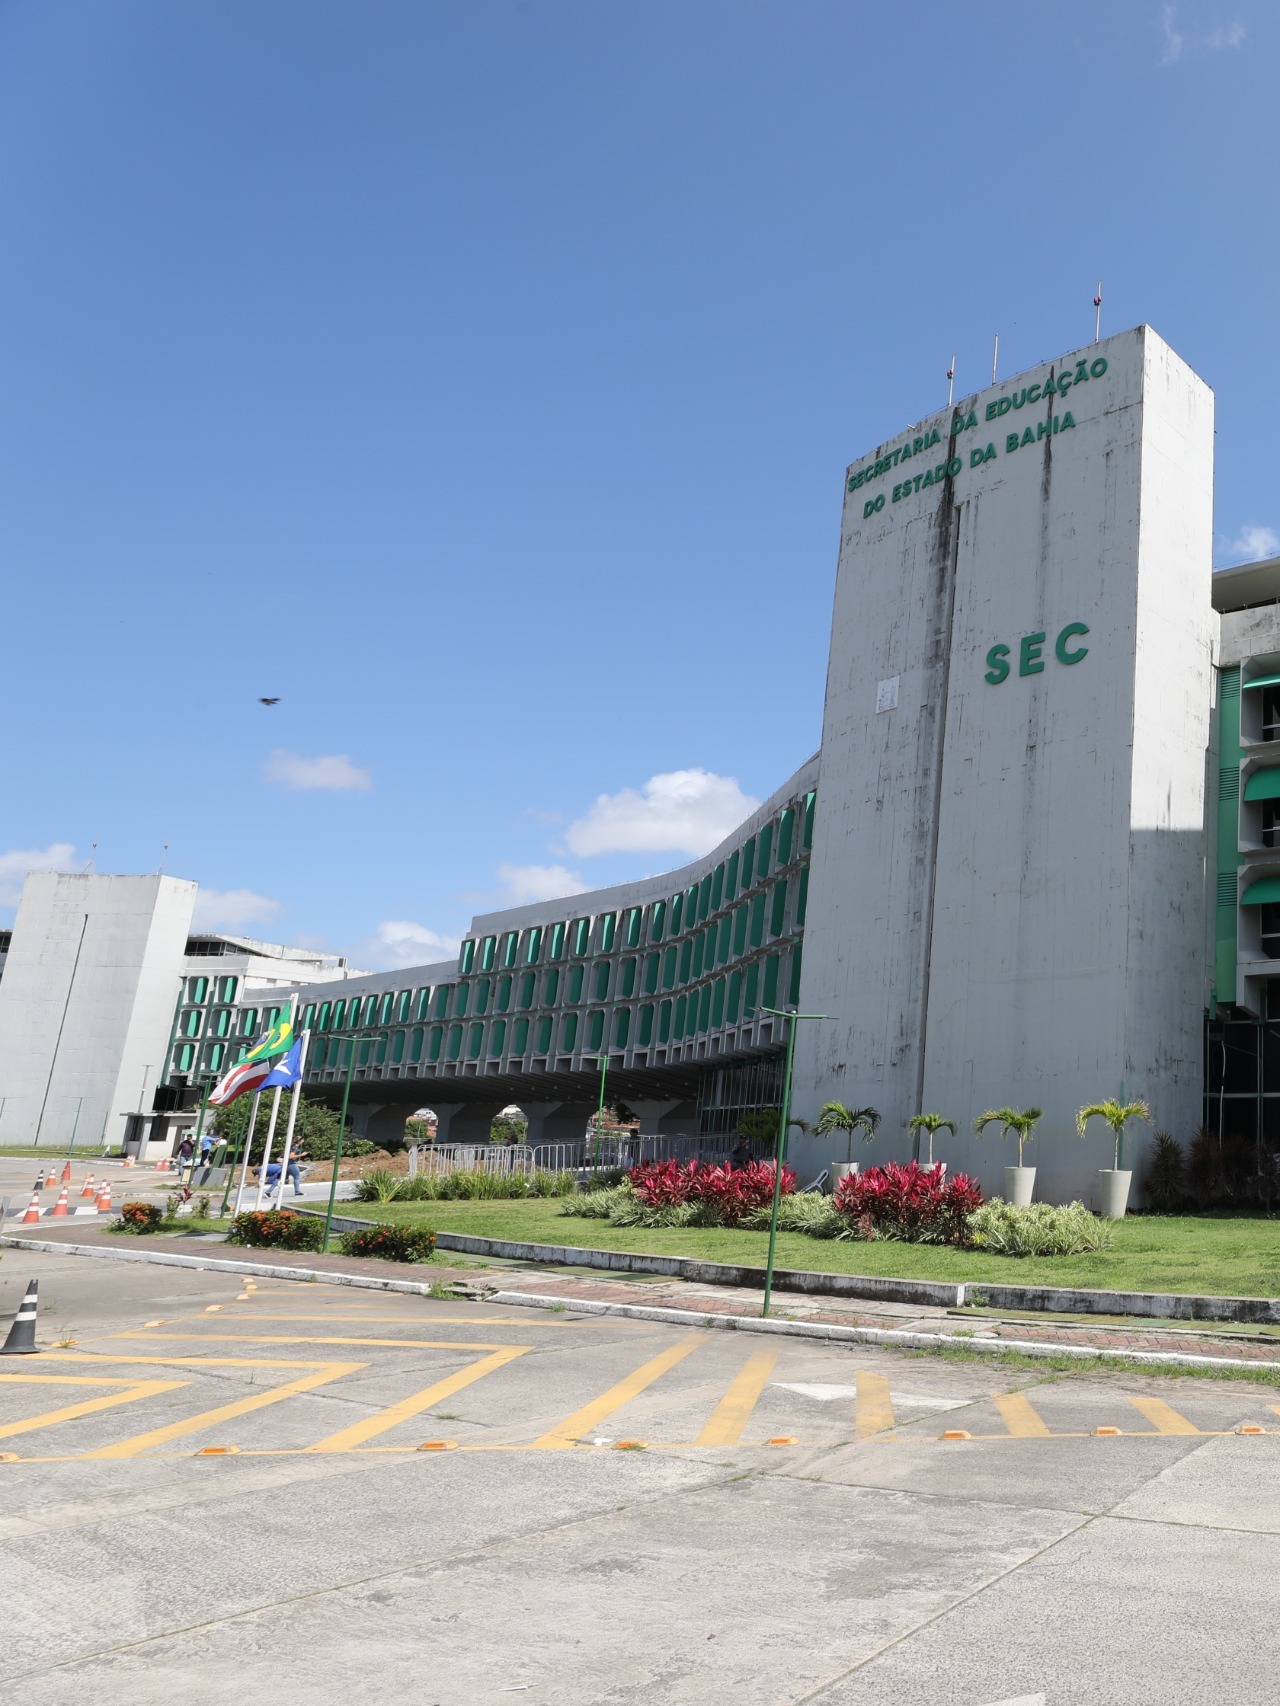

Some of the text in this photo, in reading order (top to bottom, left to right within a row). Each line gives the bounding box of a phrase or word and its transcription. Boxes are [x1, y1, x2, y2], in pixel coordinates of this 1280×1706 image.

[848, 358, 1108, 492] SECRETARIA DA EDUCAÇÃO
[862, 411, 1075, 519] DO ESTADO DA BAHIA
[985, 622, 1089, 684] SEC
